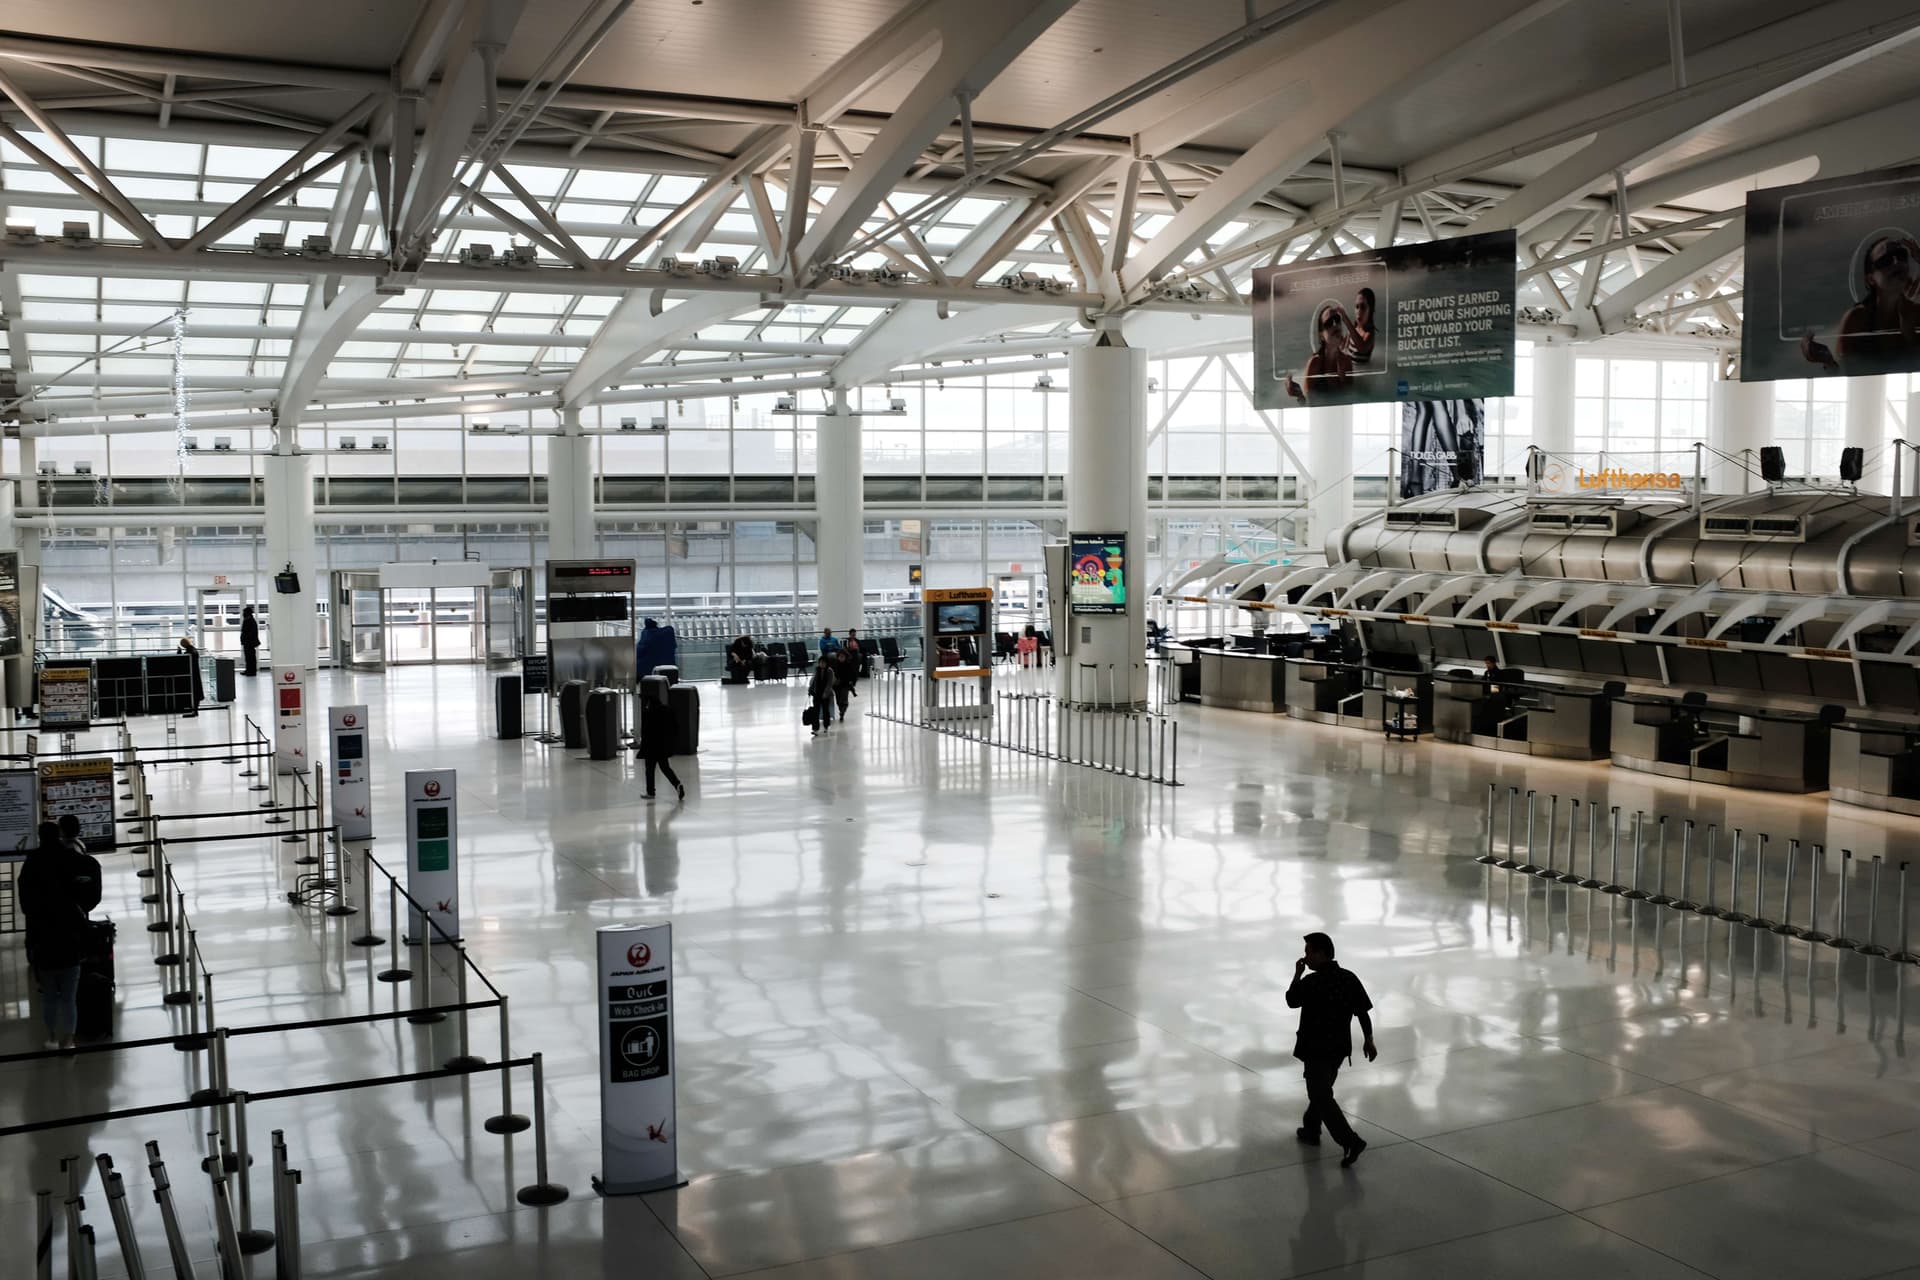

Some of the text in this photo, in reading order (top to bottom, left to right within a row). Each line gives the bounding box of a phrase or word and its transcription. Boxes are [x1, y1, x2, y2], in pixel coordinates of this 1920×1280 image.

[1398, 291, 1500, 312] PUT POINTS EARNED
[1398, 304, 1511, 325] FROM YOUR SHOPPING
[1398, 319, 1493, 338] LIST TOWARD YOUR
[1398, 335, 1461, 351] BUCKET LIST.
[1579, 467, 1681, 490] Lufthansa
[949, 591, 987, 599] Lufthansa
[614, 1005, 632, 1017] Web
[622, 1066, 660, 1079] BAG DROP
